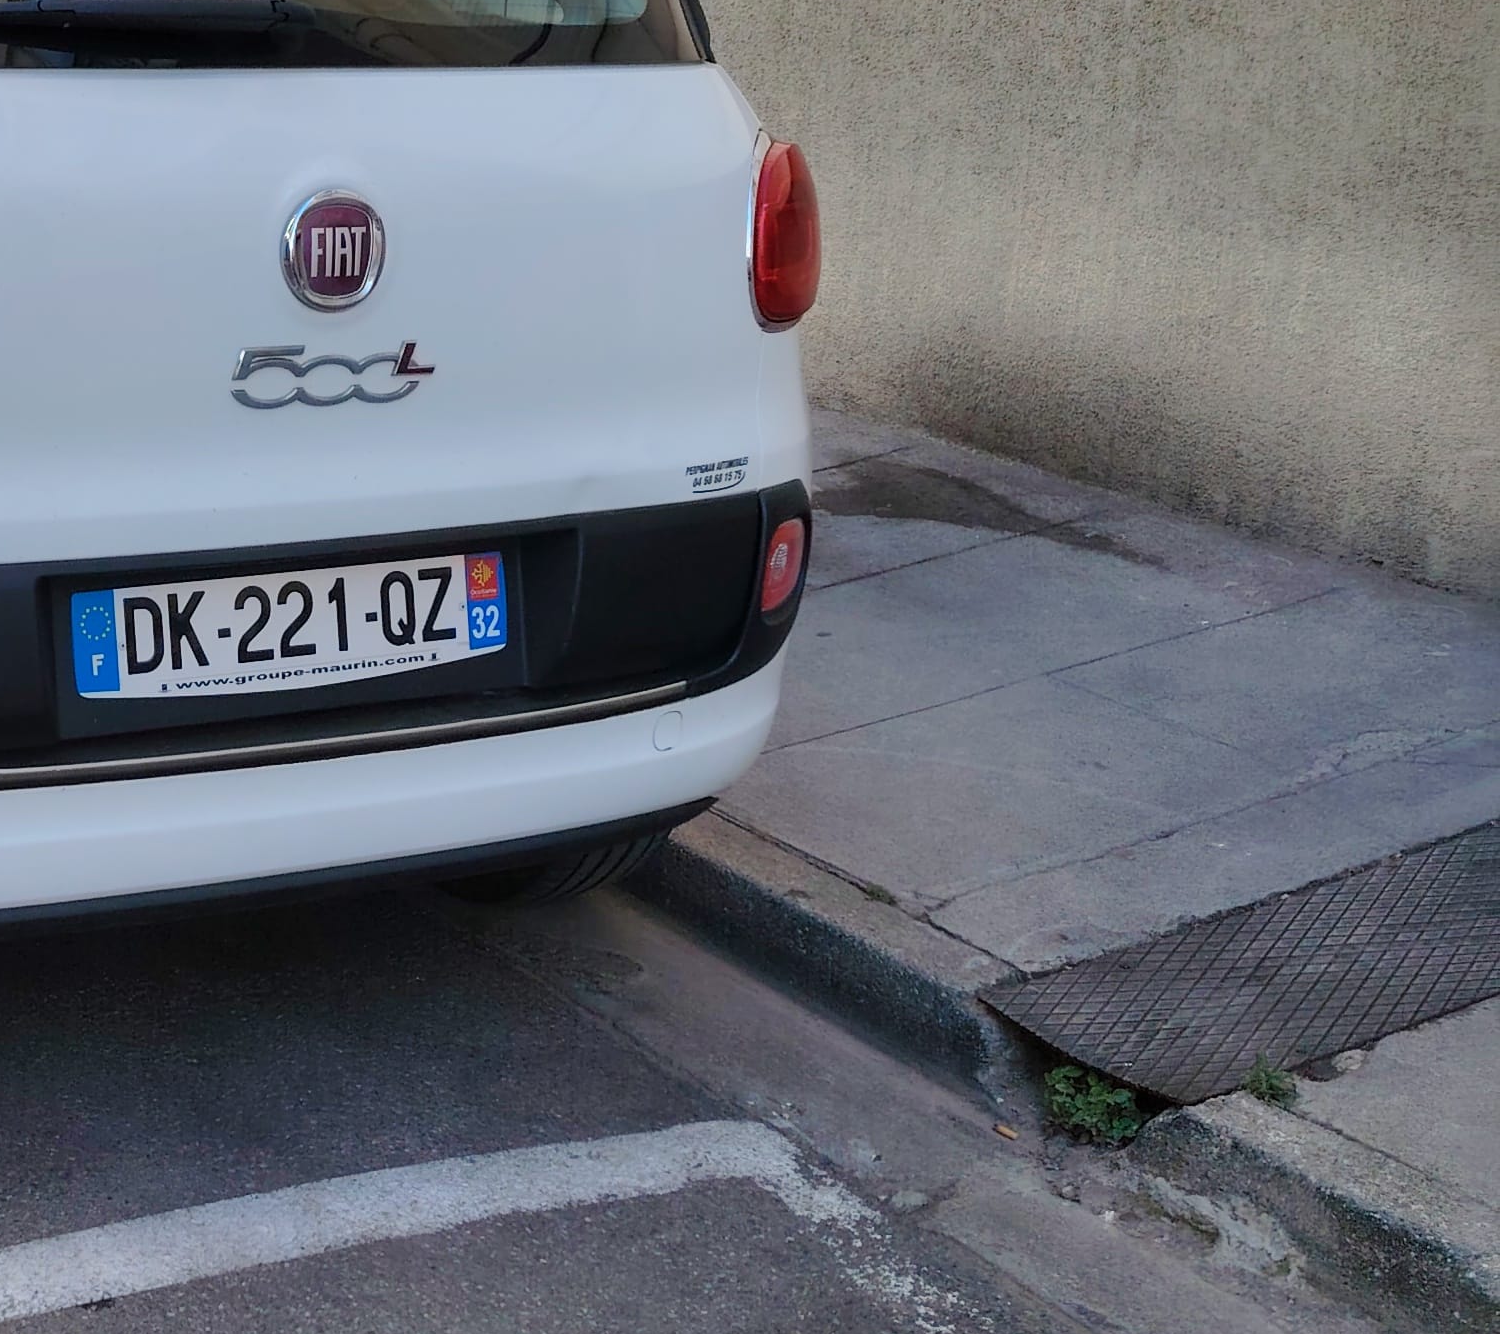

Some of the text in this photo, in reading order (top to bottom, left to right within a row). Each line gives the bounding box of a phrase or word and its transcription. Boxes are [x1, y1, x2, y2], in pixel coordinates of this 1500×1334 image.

[310, 225, 367, 278] FIAT
[230, 339, 436, 410] 500L
[122, 566, 457, 675] DK-221-QZ
[471, 604, 501, 639] 32
[92, 653, 105, 676] F
[175, 653, 425, 691] www.groupe-maurin.com
